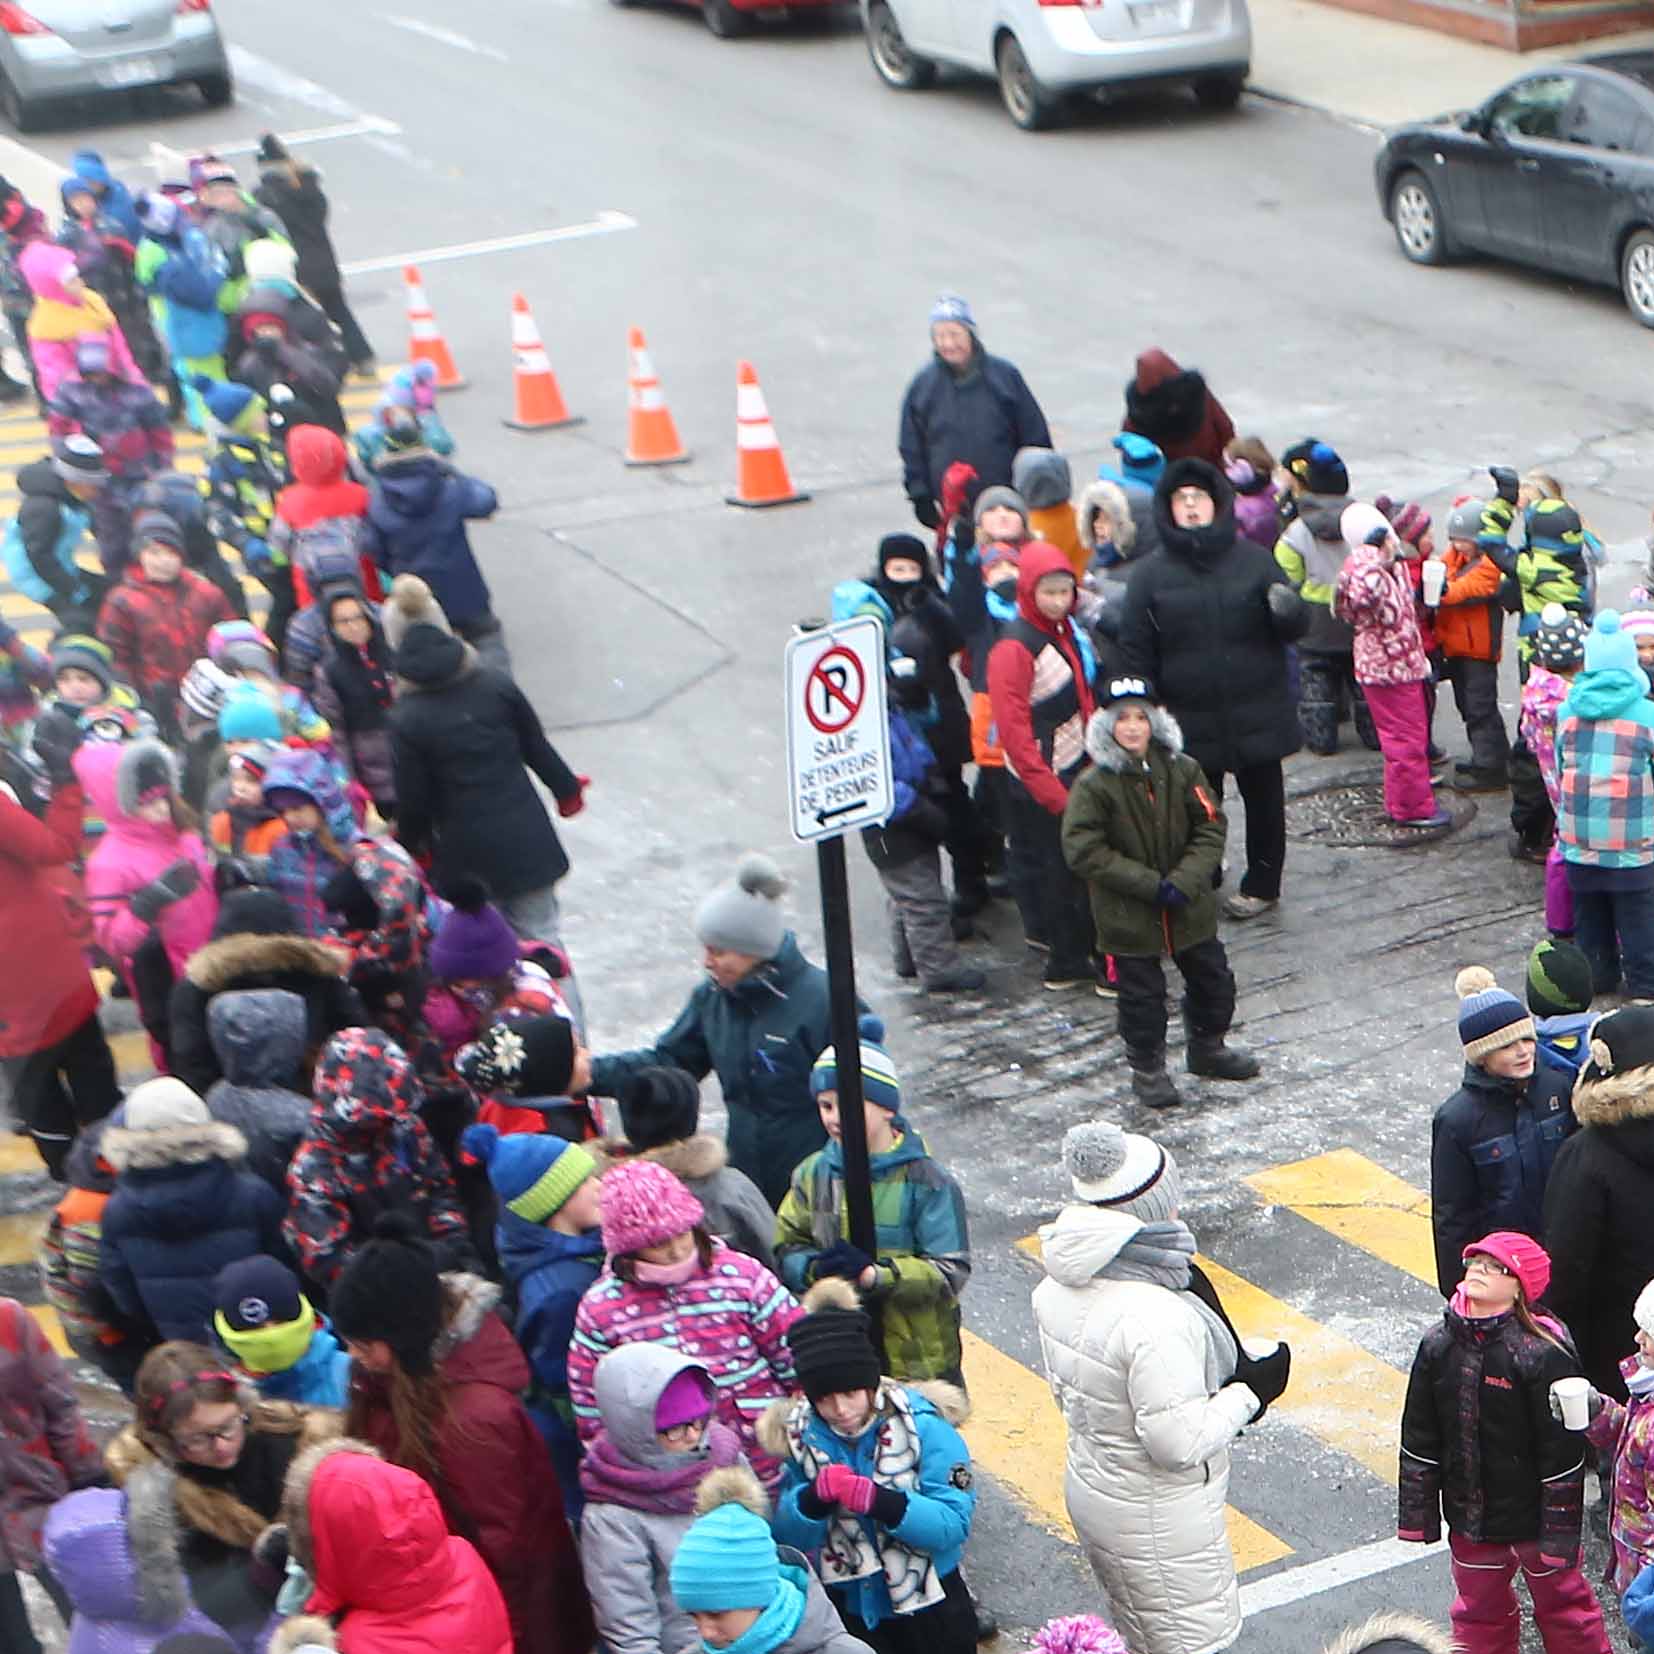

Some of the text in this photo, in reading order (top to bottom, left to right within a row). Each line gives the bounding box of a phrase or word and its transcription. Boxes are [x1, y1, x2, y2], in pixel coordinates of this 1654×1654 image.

[813, 730, 859, 760] SAUF
[800, 774, 878, 813] DE PERMIS
